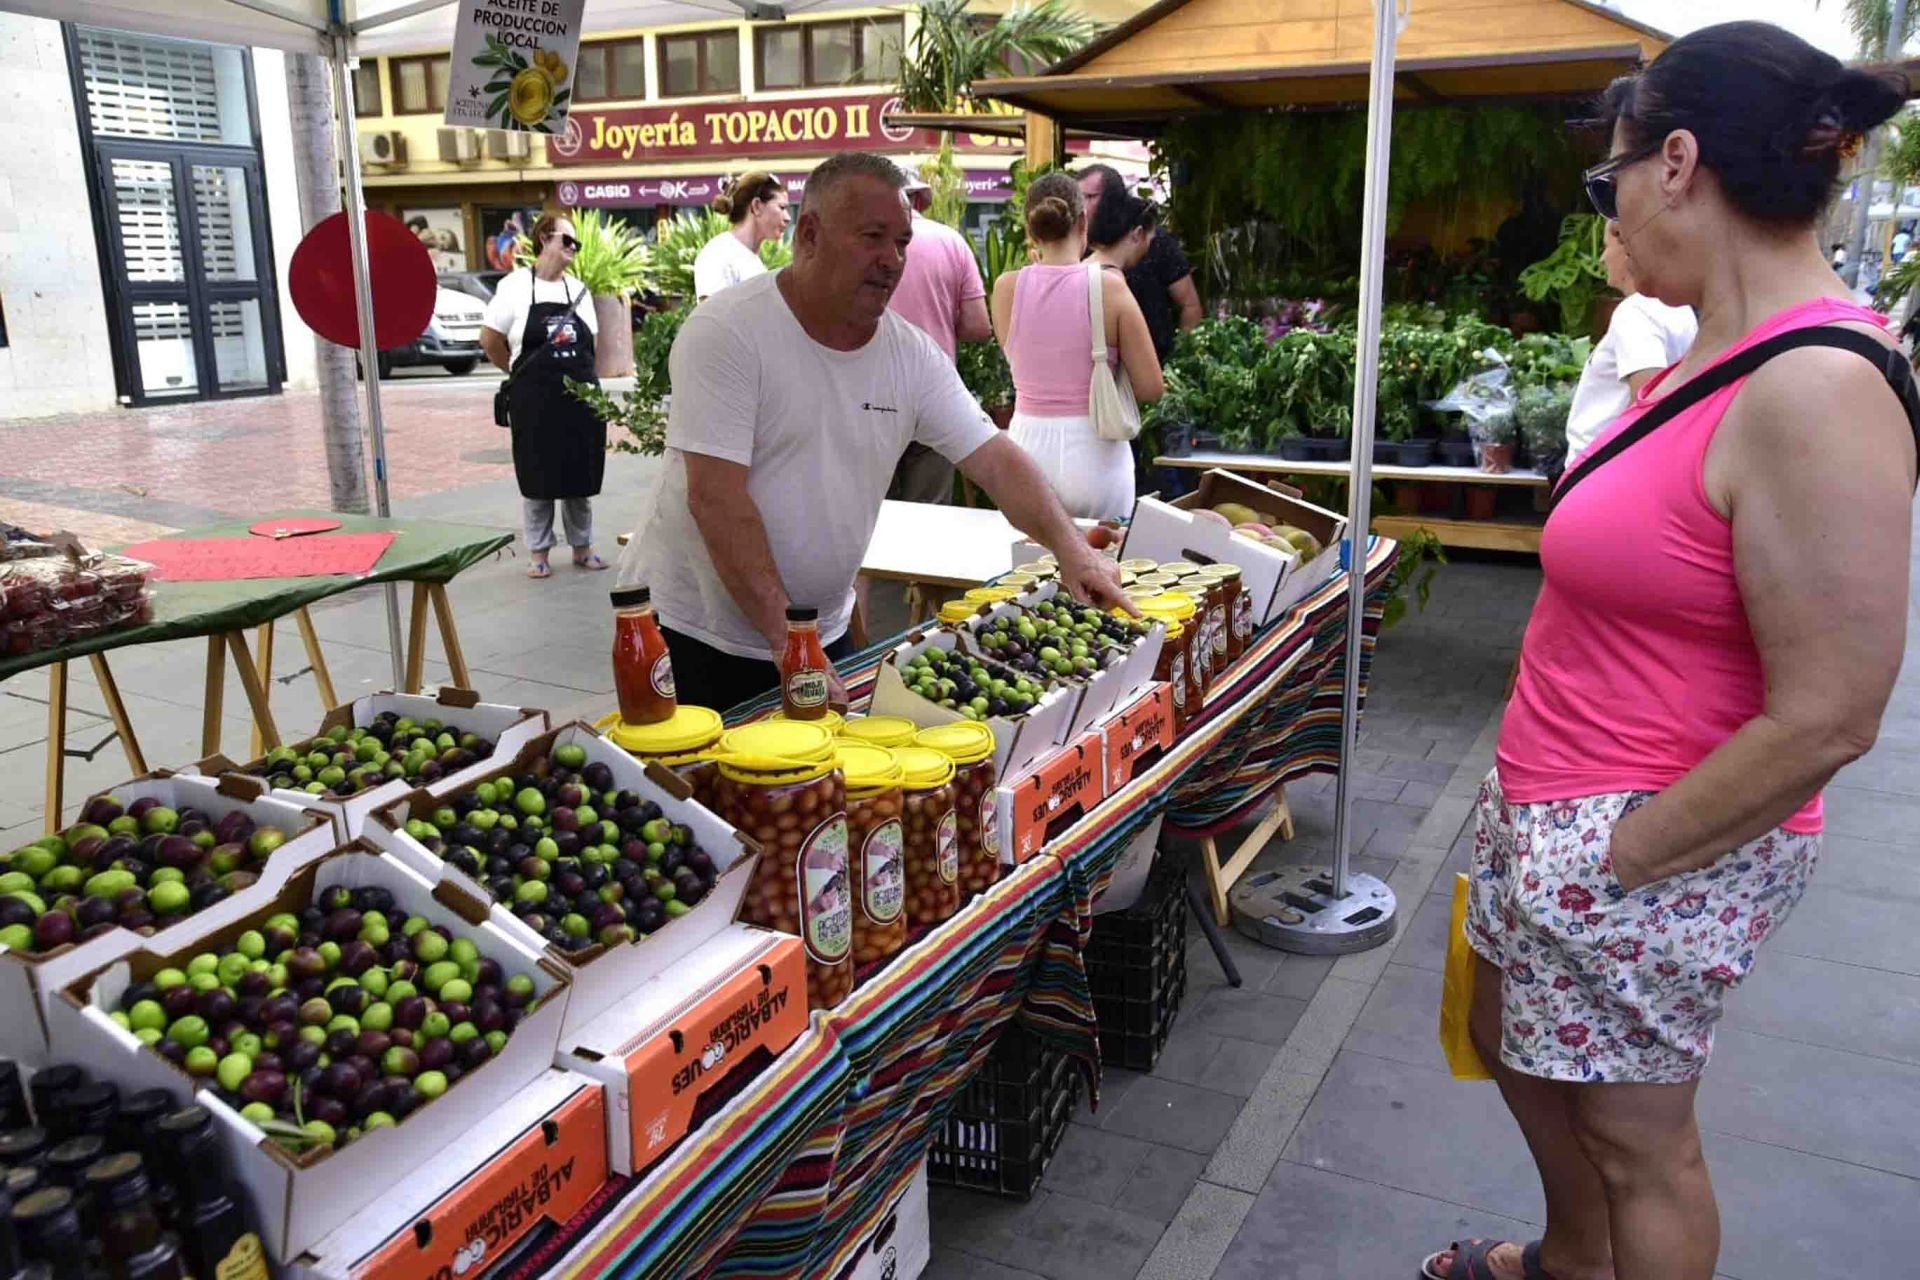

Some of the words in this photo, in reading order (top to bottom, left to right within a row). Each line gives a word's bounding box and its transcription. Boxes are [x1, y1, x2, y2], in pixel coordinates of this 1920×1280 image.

[488, 0, 537, 13] ACEITE
[541, 1, 560, 16] DE
[473, 9, 568, 36] PRODUCCION
[496, 31, 542, 50] LOCAL
[590, 112, 697, 159] Joyería
[704, 106, 838, 145] TOPACIO
[844, 104, 870, 138] II
[584, 184, 631, 198] CASIO
